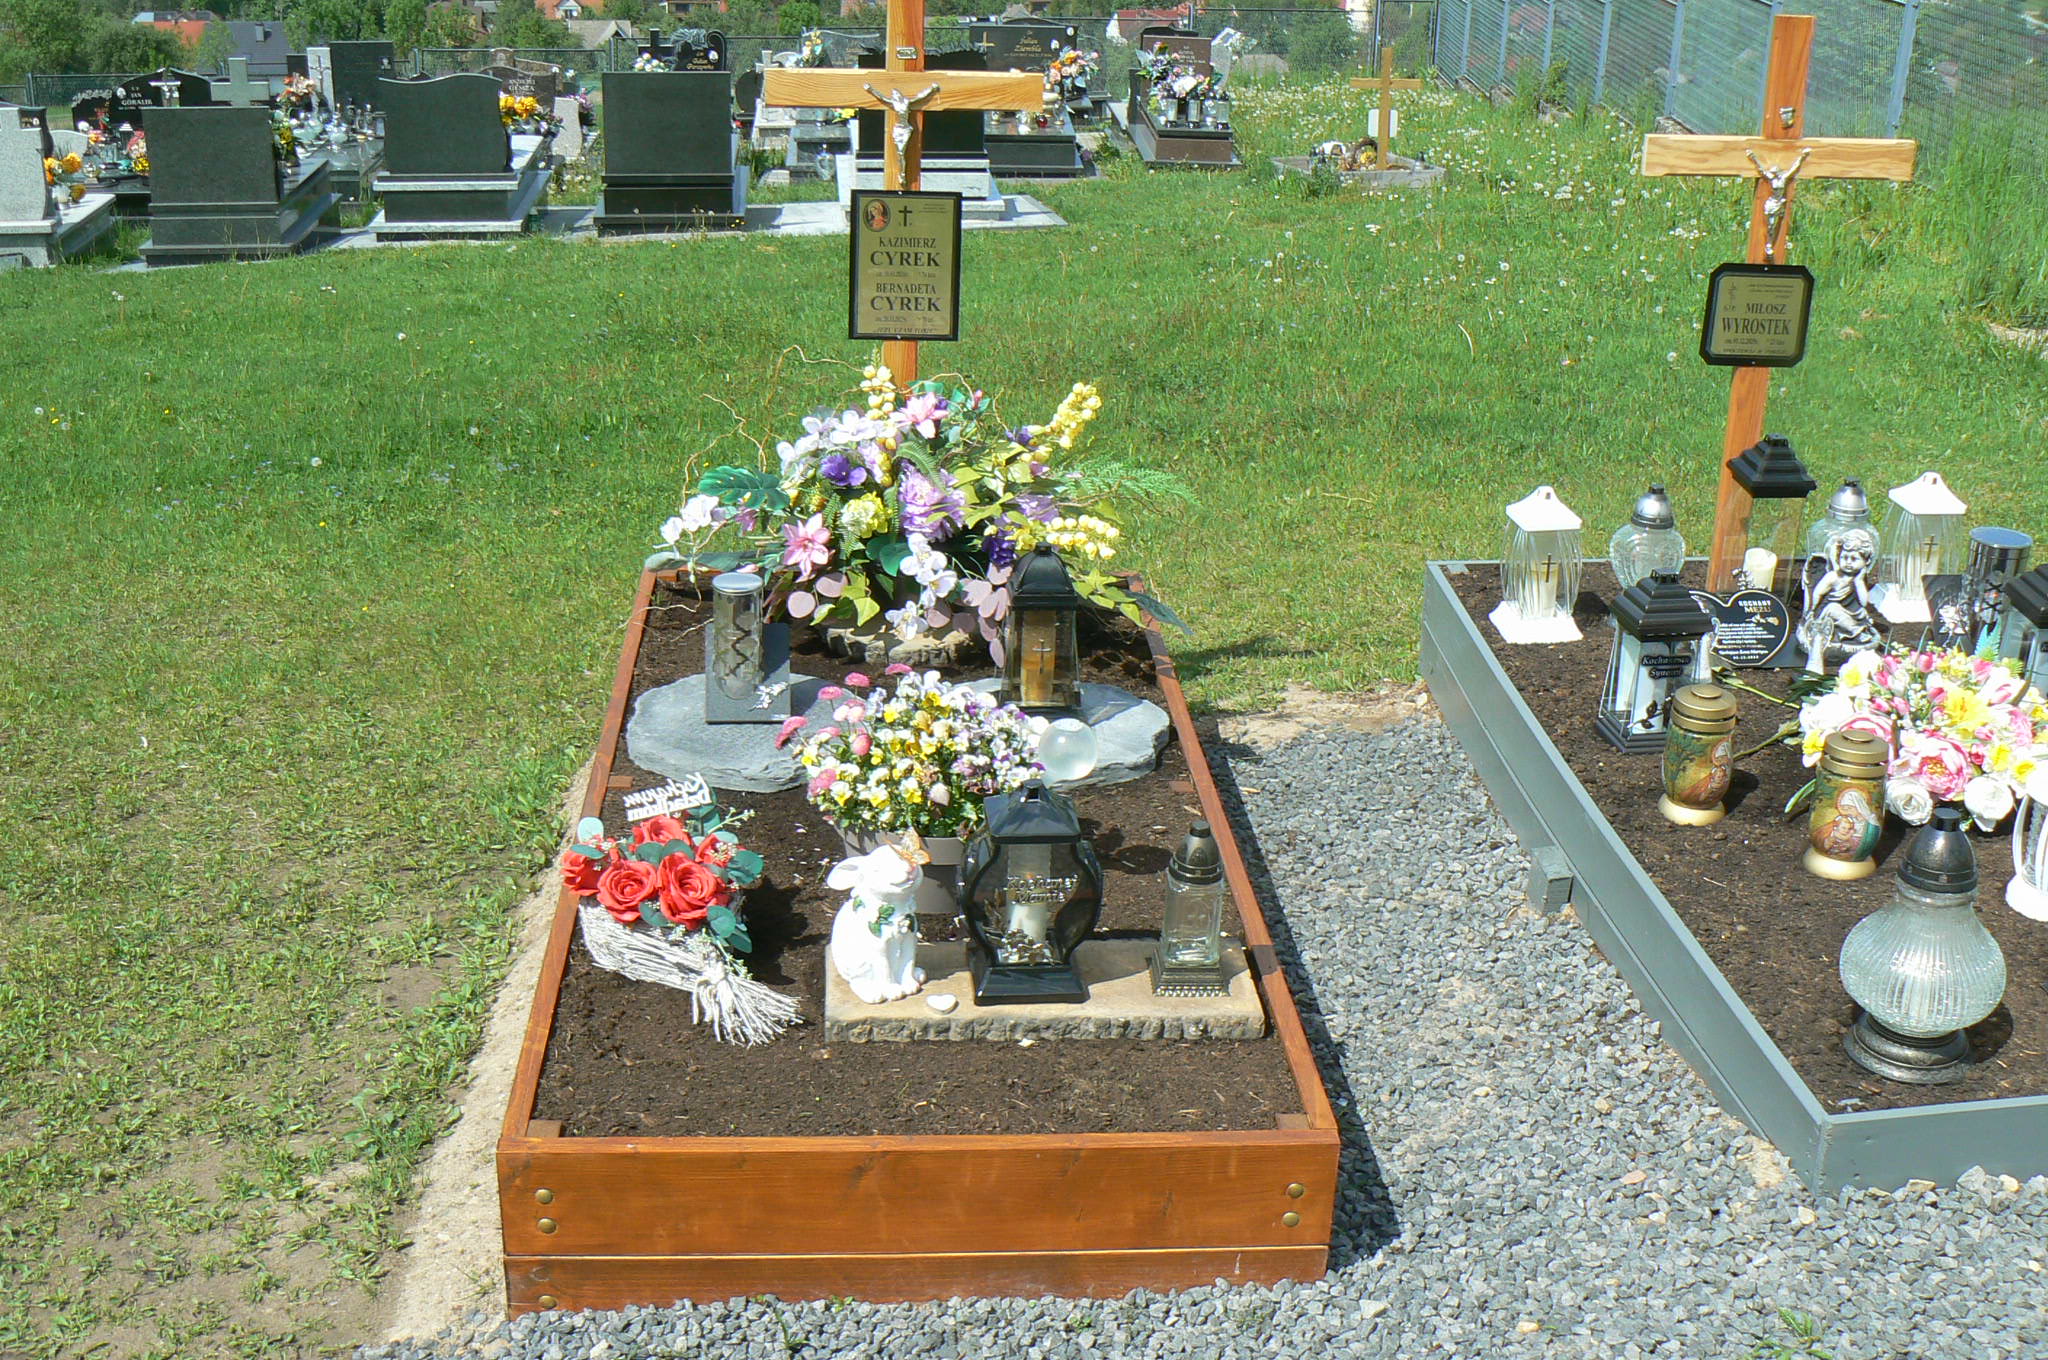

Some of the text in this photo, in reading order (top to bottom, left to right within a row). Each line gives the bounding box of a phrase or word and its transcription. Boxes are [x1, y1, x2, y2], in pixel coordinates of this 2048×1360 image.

[878, 236, 937, 249] KAZIMIERZ
[870, 251, 941, 267] CYREK
[875, 282, 937, 295] BERNADETA
[870, 296, 941, 312] CYREK
[1721, 317, 1792, 336] WYROSTEK
